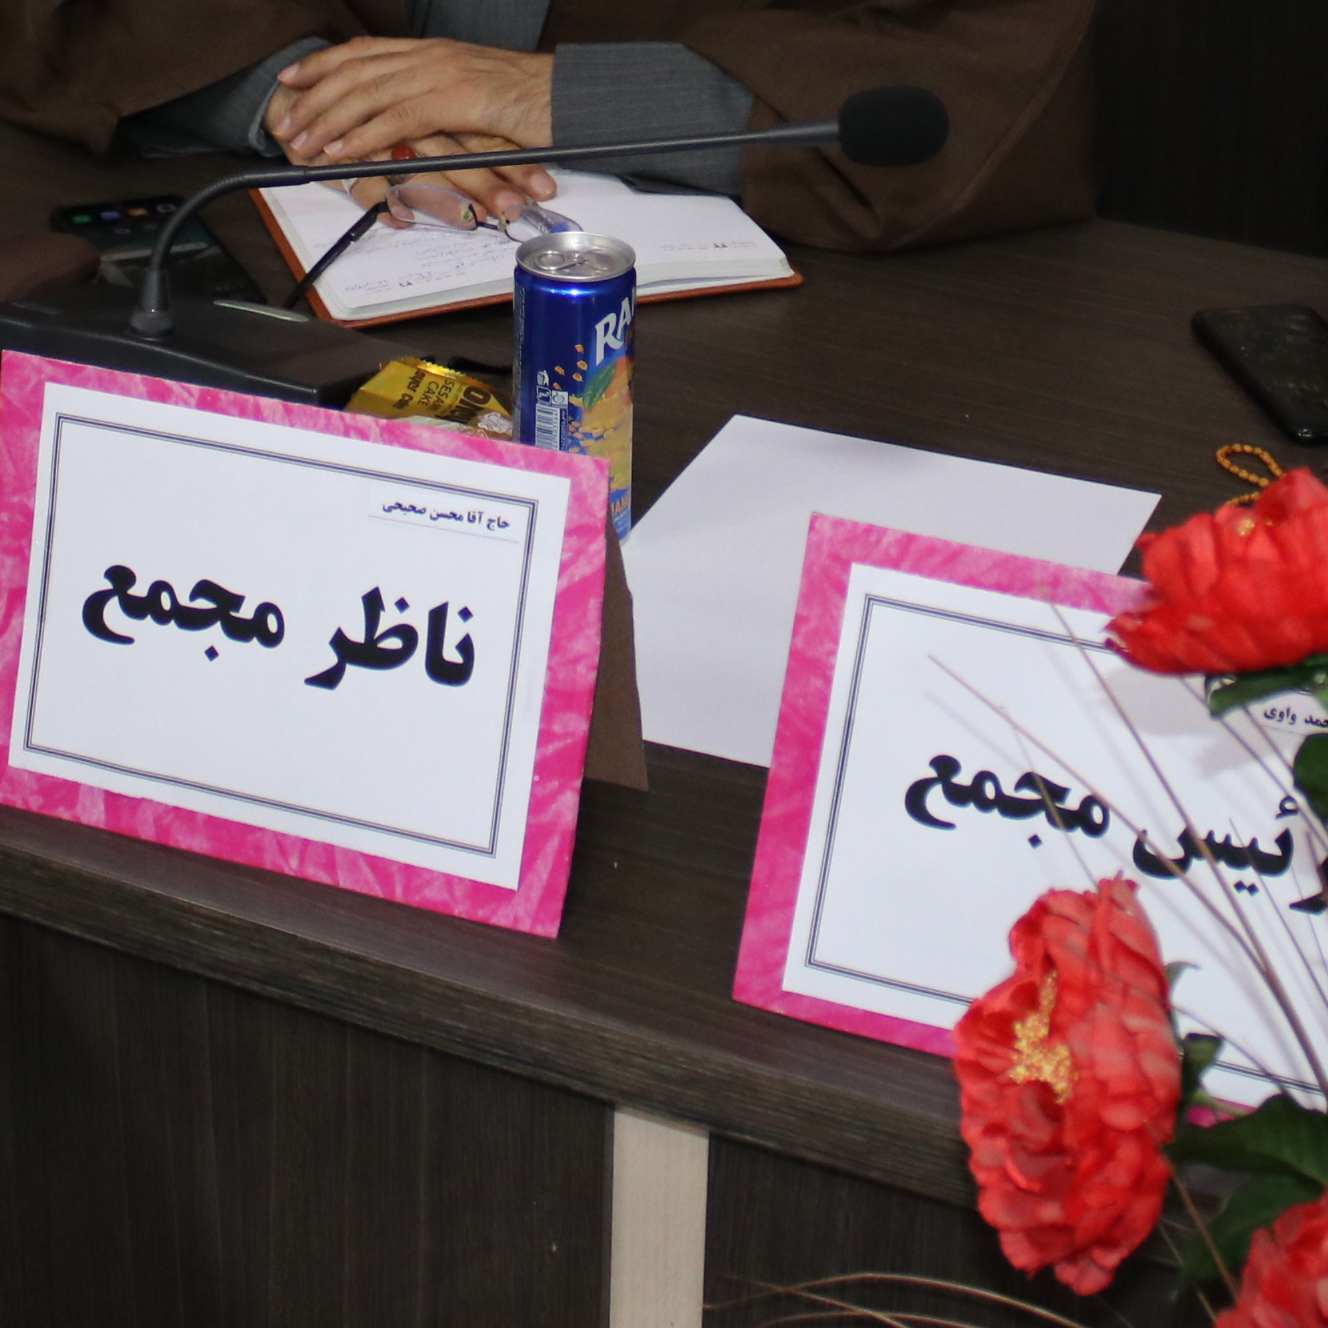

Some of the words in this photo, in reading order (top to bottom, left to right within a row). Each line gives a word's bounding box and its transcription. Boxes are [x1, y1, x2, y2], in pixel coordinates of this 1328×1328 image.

[382, 501, 427, 516] صحیحی
[429, 509, 464, 522] محسن
[467, 511, 484, 524] آقا
[486, 516, 510, 531] حاج
[81, 564, 285, 663] مجمع
[304, 586, 475, 691] ناظر
[904, 754, 1111, 848] مجمع
